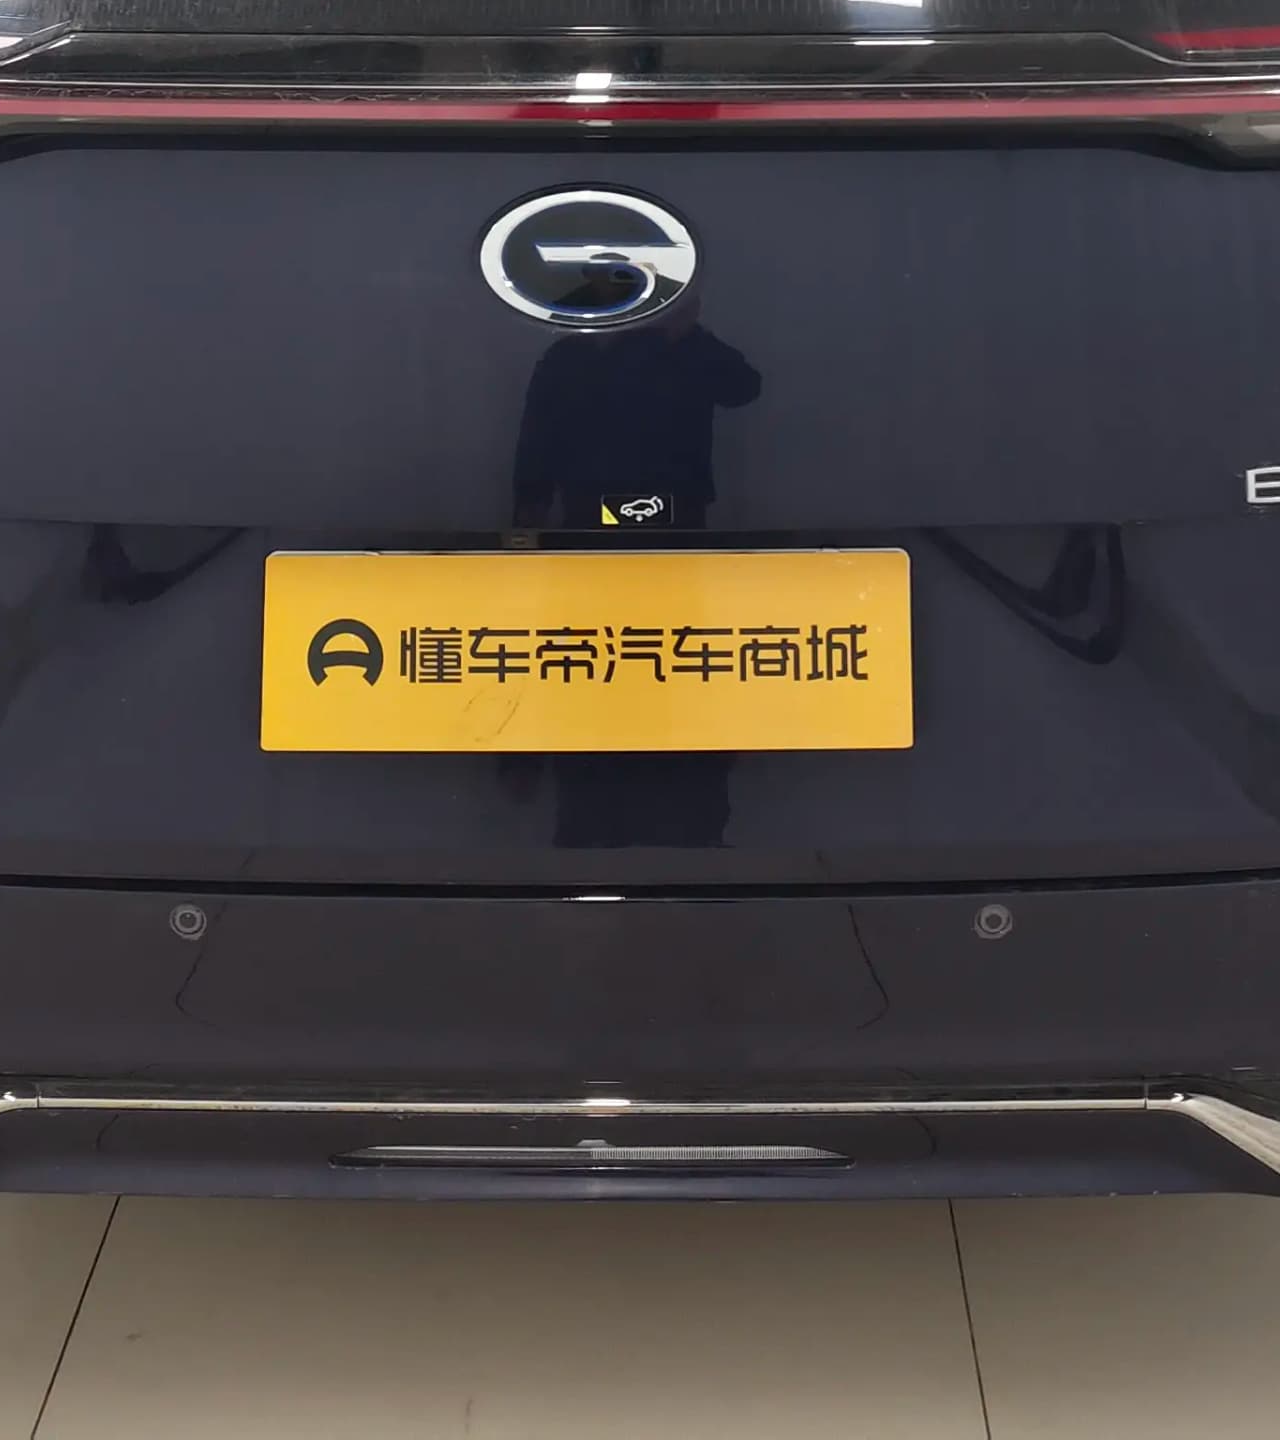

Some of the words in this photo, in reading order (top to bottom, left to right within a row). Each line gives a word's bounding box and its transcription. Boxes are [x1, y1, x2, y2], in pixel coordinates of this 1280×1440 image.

[399, 624, 868, 683] 懂车帝汽车商城
